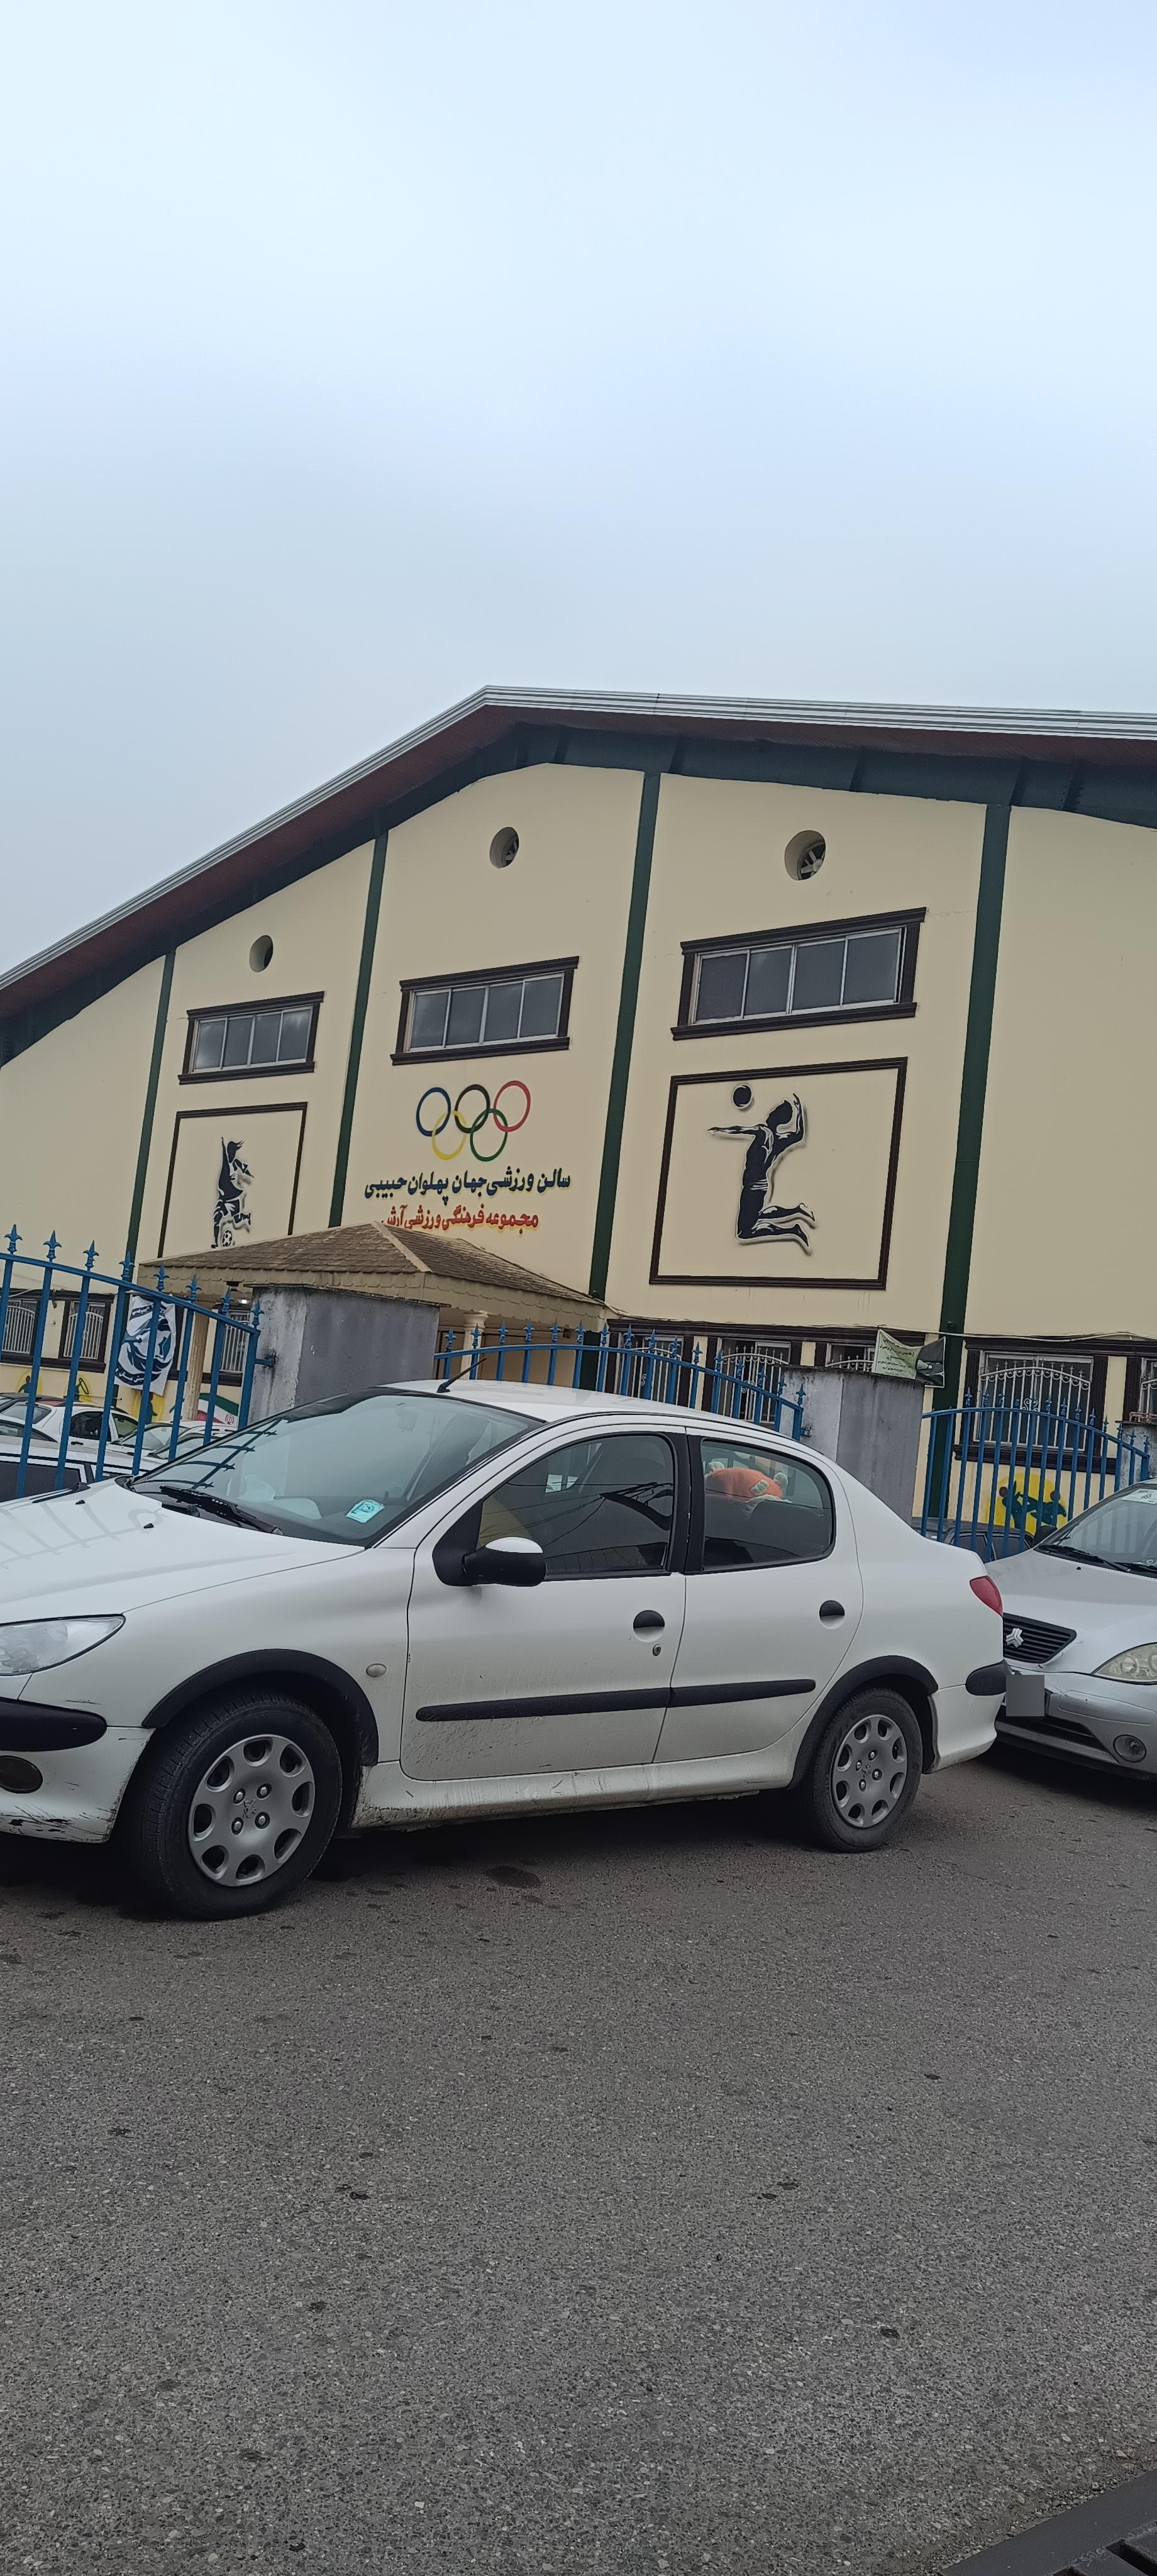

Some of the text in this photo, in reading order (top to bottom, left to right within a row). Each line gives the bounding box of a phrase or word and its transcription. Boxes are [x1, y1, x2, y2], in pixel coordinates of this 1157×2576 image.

[364, 1166, 571, 1206] سالن ورزشی جهان پهلوان حبیبی
[404, 1204, 441, 1230] ورزشی
[441, 1203, 485, 1231] فرهنگی
[485, 1213, 539, 1235] مجموعه
